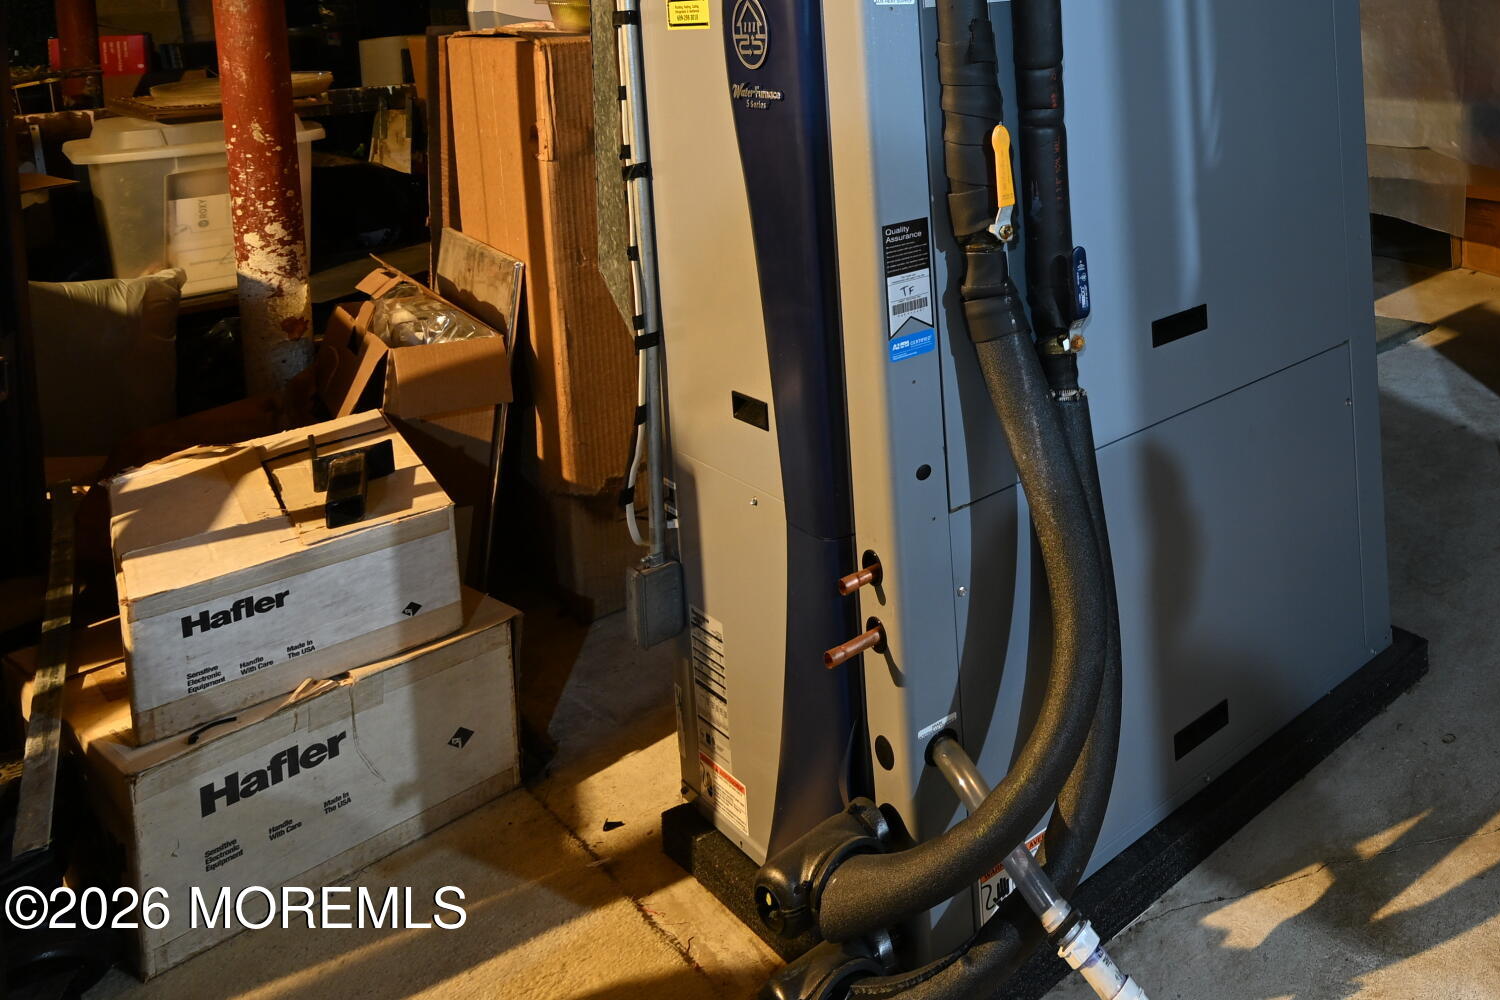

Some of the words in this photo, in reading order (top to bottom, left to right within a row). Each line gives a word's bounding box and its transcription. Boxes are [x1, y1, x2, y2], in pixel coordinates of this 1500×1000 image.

[750, 100, 767, 109] Series
[885, 225, 910, 237] Quality
[885, 231, 922, 244] Assurance
[181, 589, 290, 639] Hafler
[286, 642, 306, 653] Made
[287, 649, 301, 660] The
[301, 645, 316, 655] USA
[239, 655, 264, 669] Handle
[240, 664, 257, 676] With
[257, 659, 274, 671] Care
[186, 664, 219, 680] Sensitive
[187, 670, 222, 687] Electronic
[187, 676, 226, 694] Equipment
[200, 730, 347, 818] Hafler
[323, 793, 342, 808] Made
[323, 804, 337, 815] The
[337, 797, 352, 809] USA
[268, 818, 293, 835] Handle
[269, 826, 286, 841] With
[286, 820, 302, 834] Care
[204, 838, 238, 858] Sensitive
[205, 844, 241, 865] Electronic
[205, 849, 244, 873] Equipment
